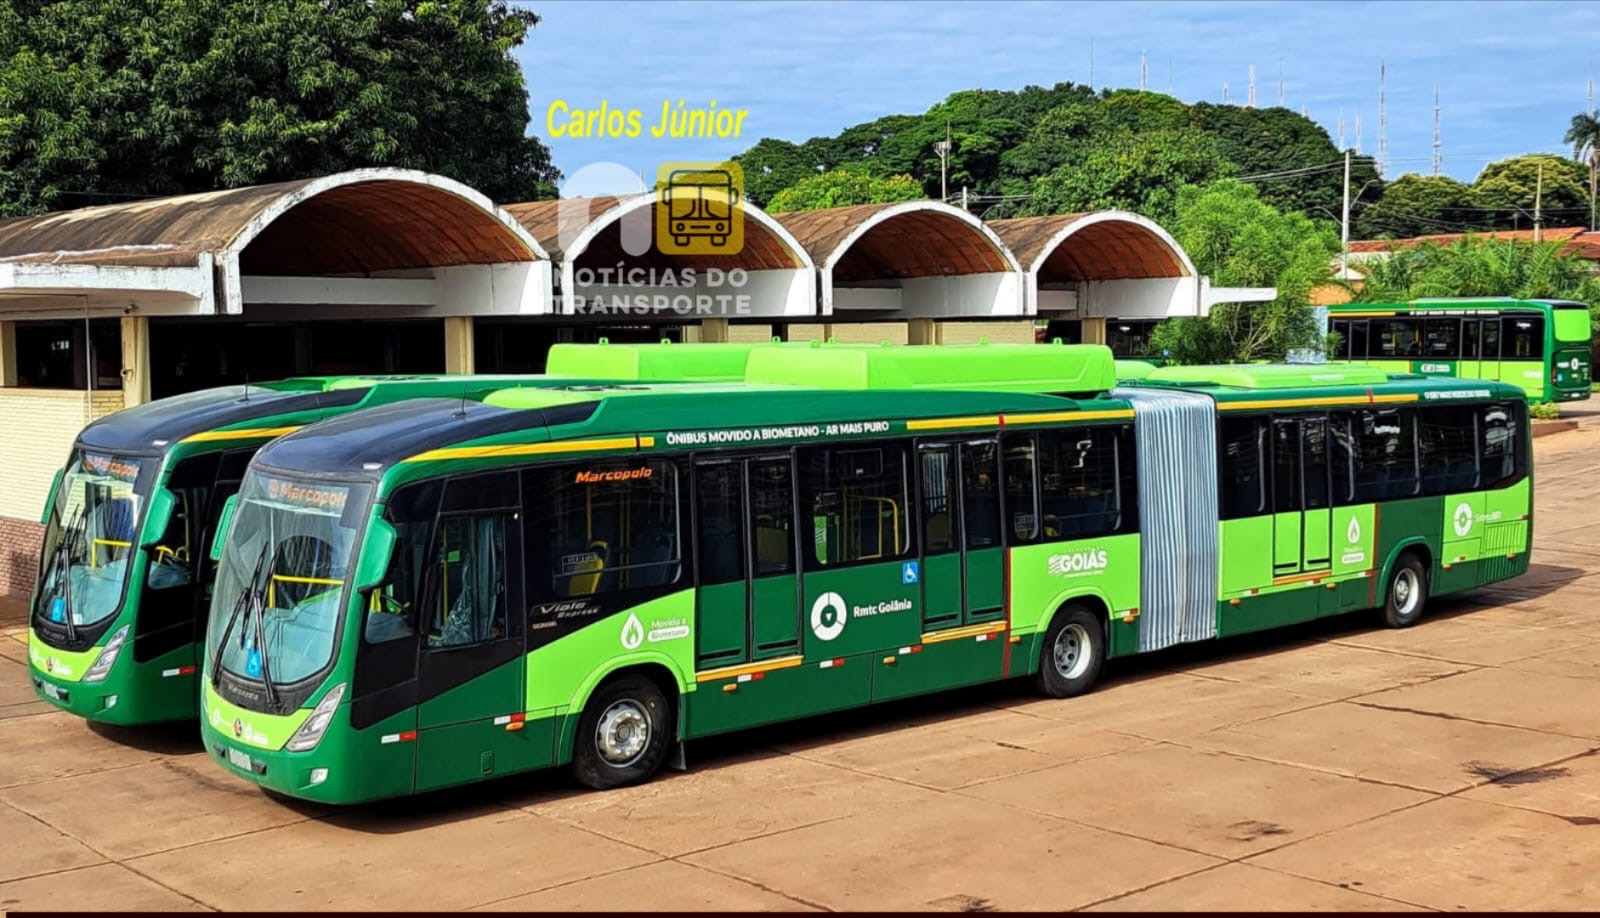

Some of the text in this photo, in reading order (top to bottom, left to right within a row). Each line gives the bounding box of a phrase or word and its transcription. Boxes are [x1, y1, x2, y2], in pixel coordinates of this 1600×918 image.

[666, 431, 708, 445] ÔNIBUS
[709, 429, 751, 443] MOVIDO
[753, 429, 762, 440] A
[762, 425, 820, 439] BIOMETANO
[826, 424, 839, 435] AR
[840, 422, 863, 434] MAIS
[864, 420, 890, 432] PURO
[575, 466, 653, 484] Marcopolo
[1060, 547, 1108, 572] GOIÁS
[540, 601, 588, 615] Viale
[853, 598, 912, 618] Rmtc Goiânia
